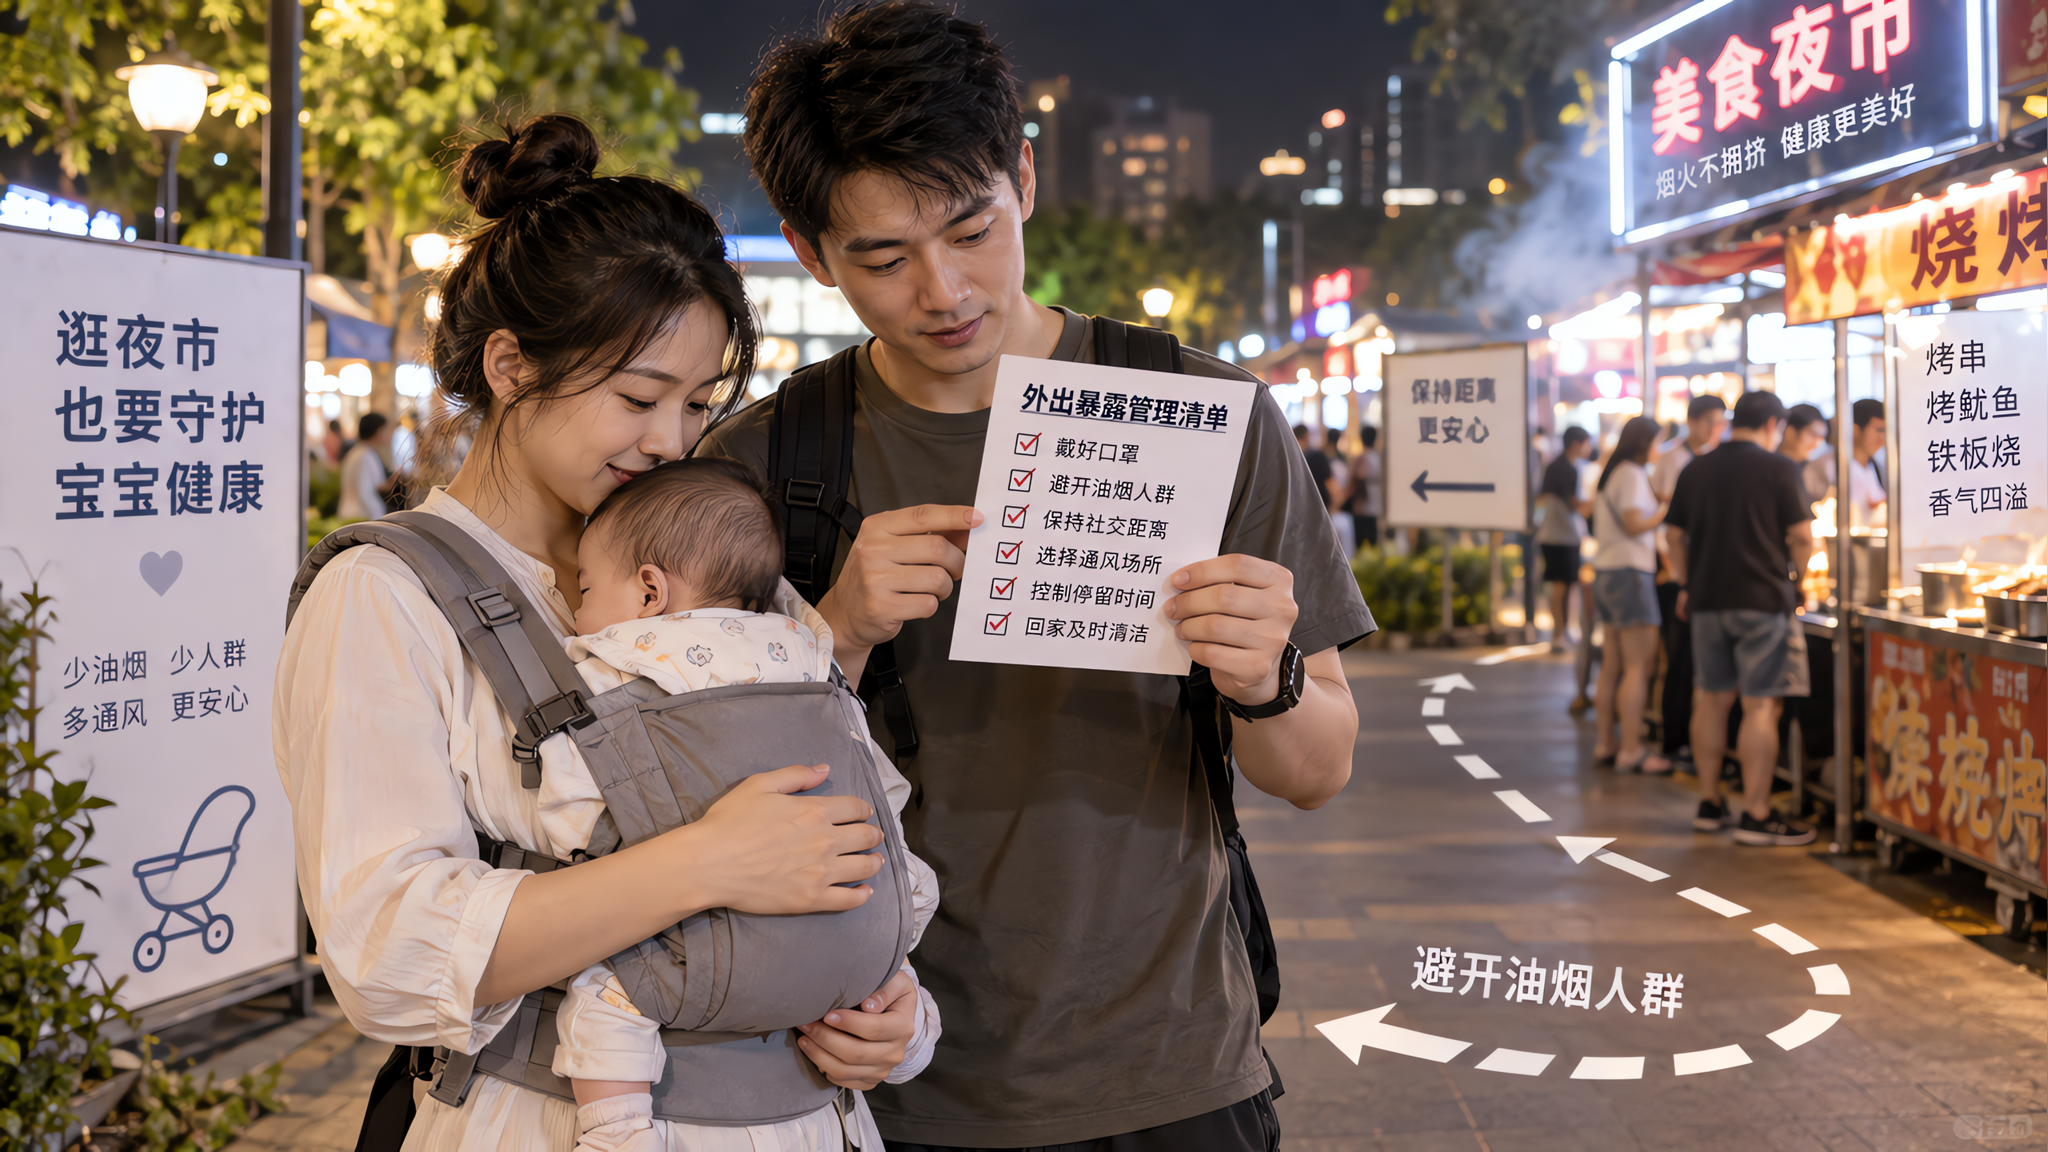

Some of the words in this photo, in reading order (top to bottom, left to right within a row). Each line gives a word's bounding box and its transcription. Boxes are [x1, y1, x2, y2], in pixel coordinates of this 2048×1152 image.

[1652, 0, 1911, 157] 美食夜市
[1655, 136, 1767, 201] 烟火不拥挤
[1779, 83, 1917, 160] 健康更美好
[55, 309, 219, 372] 逛夜市
[1926, 339, 1986, 376] 烤串
[54, 386, 265, 443] 也要守护
[1020, 382, 1229, 431] 外出暴露管理清单
[1926, 385, 2021, 425] 烤鱿鱼
[1417, 416, 1490, 444] 更安心
[1927, 434, 2021, 473] 铁板烧
[55, 459, 265, 520] 宝宝健康
[1048, 473, 1176, 505] 避开油烟人群
[1928, 482, 2029, 518] 香气四溢
[1042, 509, 1169, 540] 保持社交距离
[1035, 545, 1163, 575] 选择通风场所
[1029, 580, 1156, 609] 控制停留时间
[63, 650, 147, 690] 少油烟
[170, 638, 247, 676] 少人群
[63, 698, 148, 740] 多通风
[170, 684, 249, 723] 更安心
